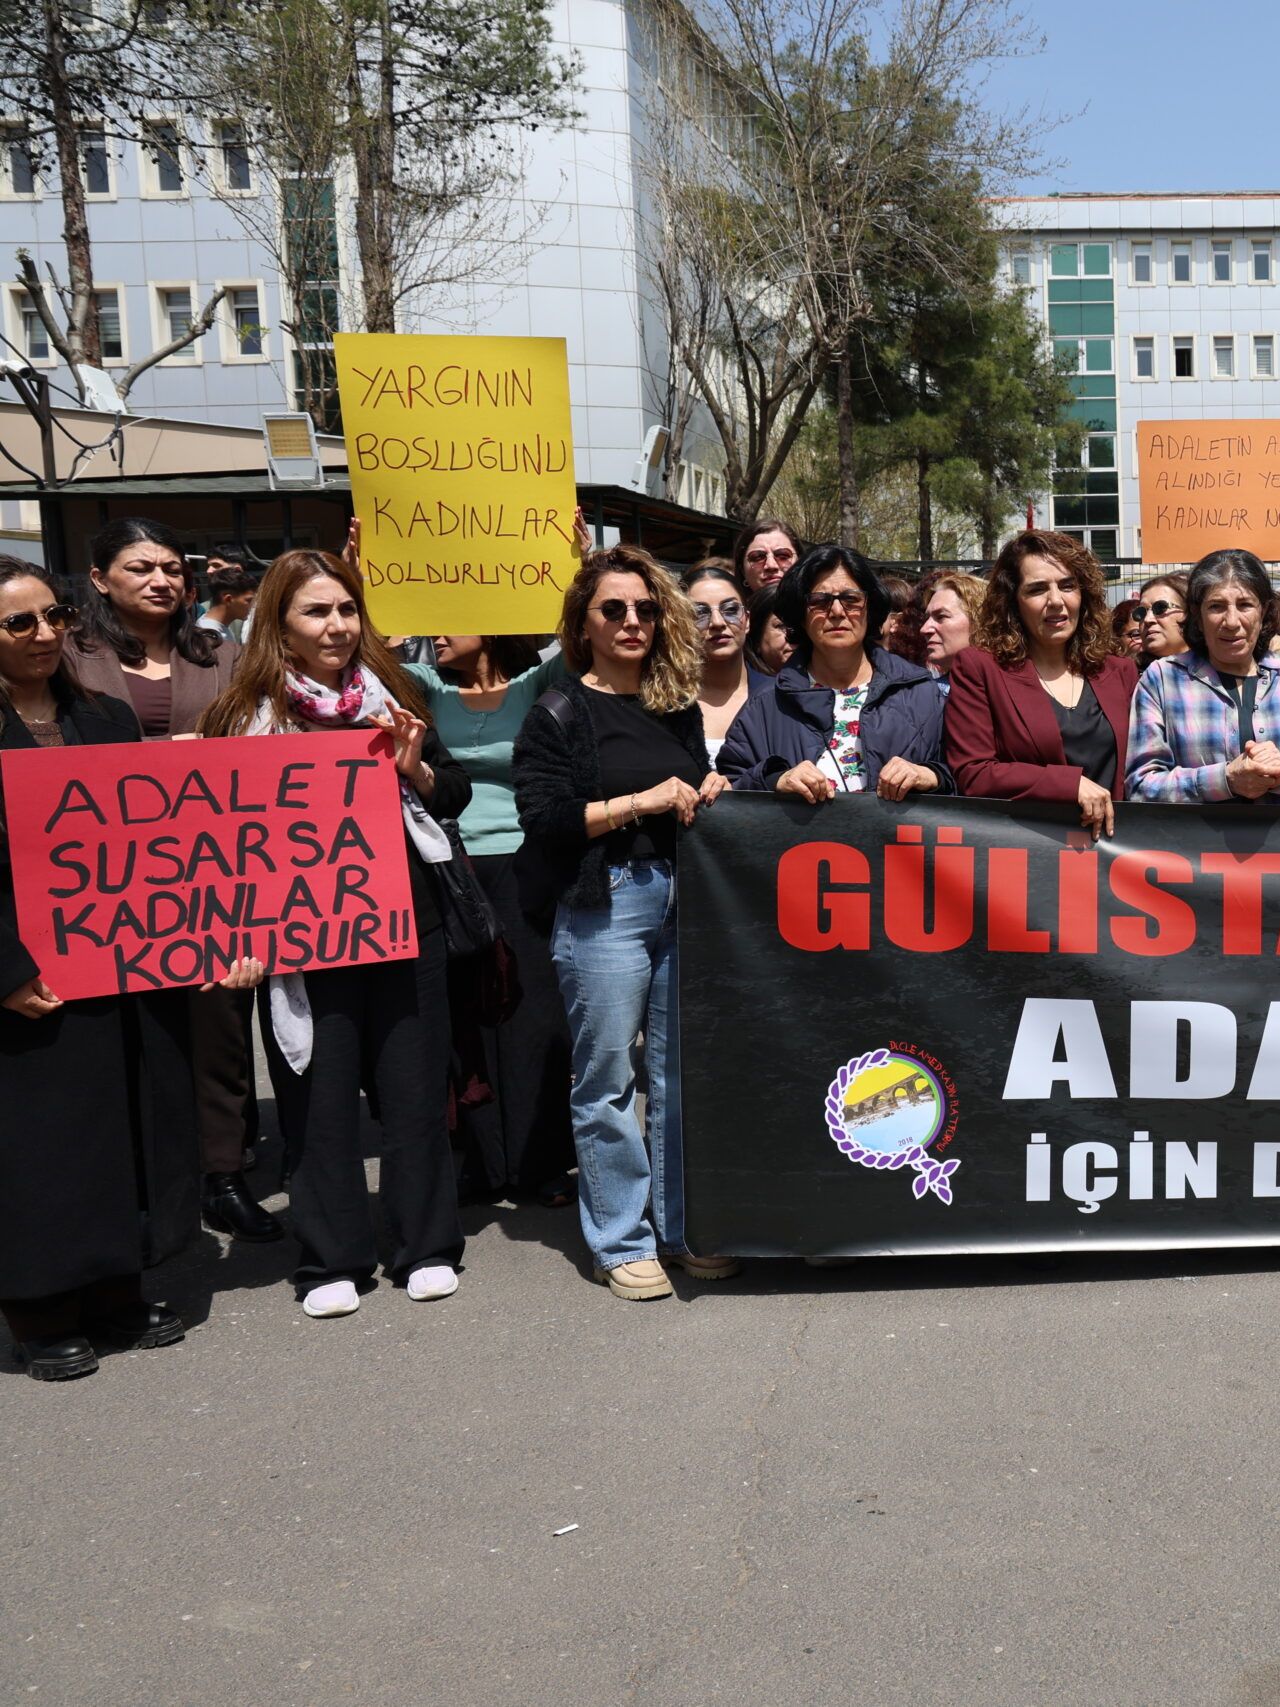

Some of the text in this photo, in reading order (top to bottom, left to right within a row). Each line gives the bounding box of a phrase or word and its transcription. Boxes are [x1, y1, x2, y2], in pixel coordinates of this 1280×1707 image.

[352, 365, 533, 409] YARGININ
[355, 433, 567, 475] BOŞLUĞUNU
[1149, 434, 1252, 461] ADALETİN
[1155, 470, 1242, 491] ALINDIĞI
[374, 497, 572, 544] KADINLAR
[1156, 505, 1254, 531] KADINLAR
[367, 559, 564, 592] DOLDURUYOR
[45, 760, 379, 834] ADALET
[47, 816, 375, 898] SUSARSA
[52, 865, 379, 955] KADINLAR
[1026, 1131, 1218, 1213] İÇİN
